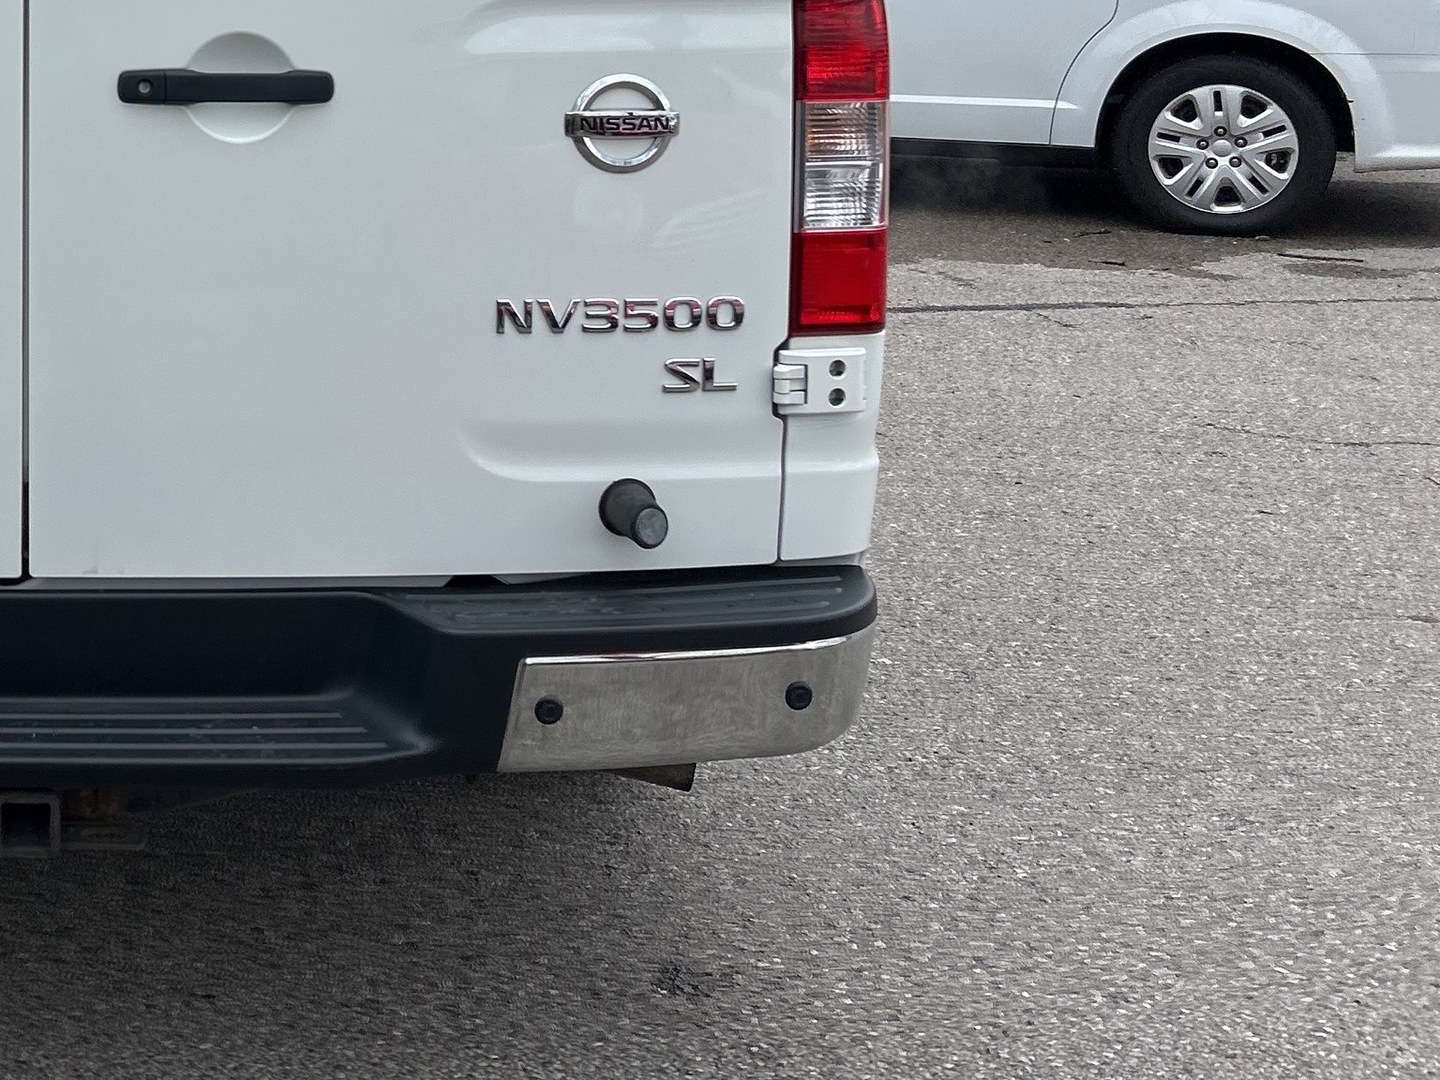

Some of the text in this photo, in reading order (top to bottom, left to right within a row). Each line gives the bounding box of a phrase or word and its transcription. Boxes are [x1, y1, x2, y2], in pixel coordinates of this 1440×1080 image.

[580, 117, 669, 131] NISSAN
[496, 296, 745, 334] NV3500
[662, 358, 738, 393] SL
